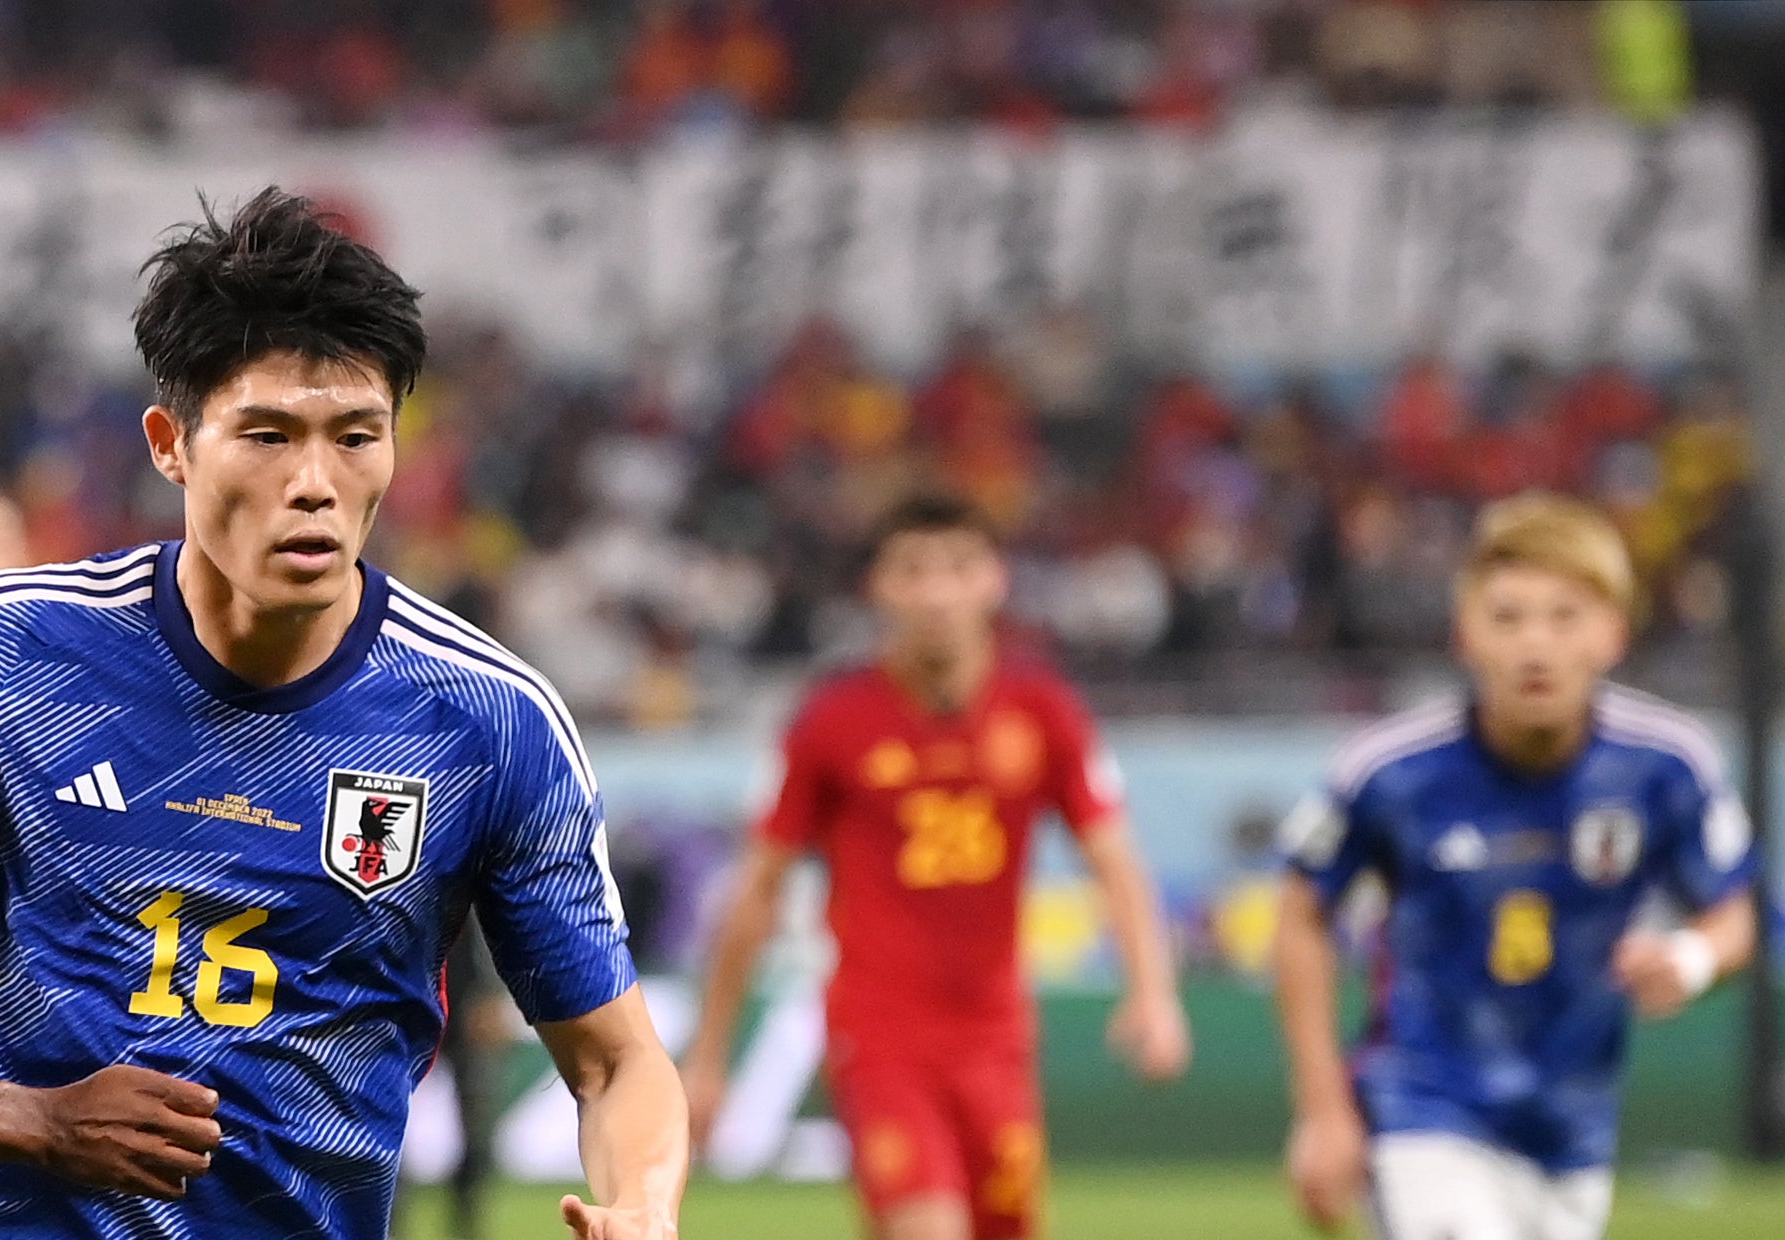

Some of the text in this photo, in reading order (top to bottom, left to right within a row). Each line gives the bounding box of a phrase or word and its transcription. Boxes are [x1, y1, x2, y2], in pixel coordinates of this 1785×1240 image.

[354, 777, 404, 792] JAPAN
[348, 855, 389, 876] JFA
[128, 890, 279, 1028] 16
